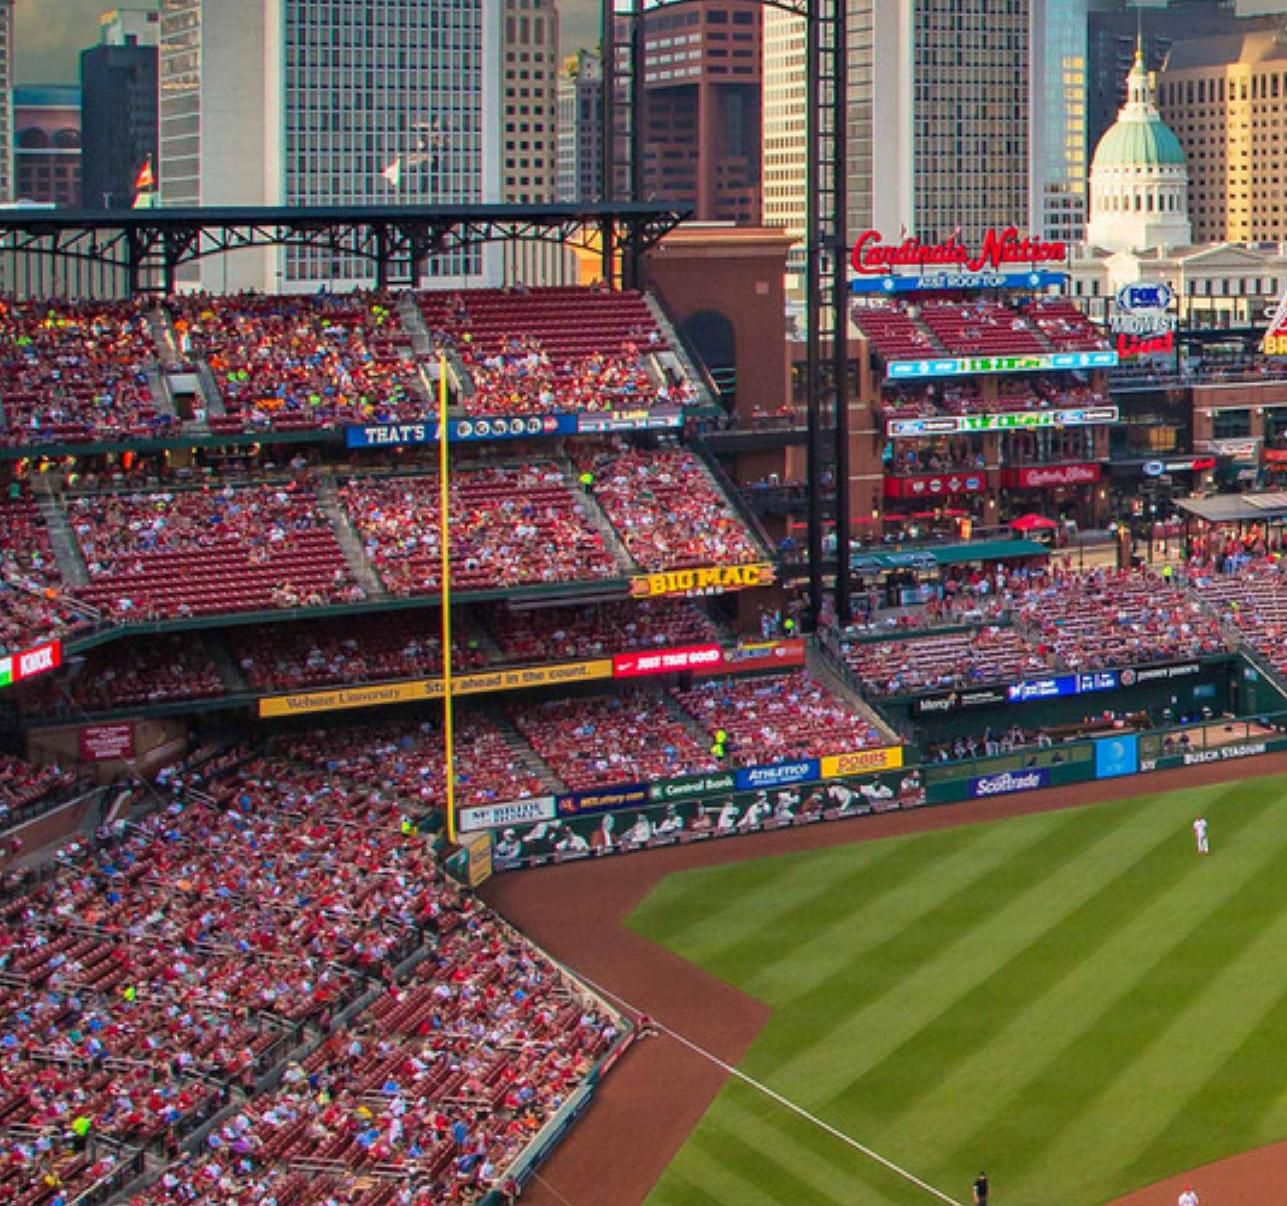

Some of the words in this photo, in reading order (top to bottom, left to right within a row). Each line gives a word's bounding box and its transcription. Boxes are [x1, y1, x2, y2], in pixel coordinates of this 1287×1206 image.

[851, 230, 968, 274] Cardinals
[967, 227, 1066, 272] Nation
[1130, 288, 1160, 302] FOX
[365, 424, 425, 443] THAT'S
[650, 569, 694, 597] BIG
[695, 564, 761, 587] MAC
[459, 674, 501, 690] ahead
[506, 672, 518, 686] in
[522, 669, 544, 683] the
[920, 699, 951, 713] Mercy
[1184, 751, 1219, 765] BUSCH
[1221, 742, 1266, 759] STADIUM
[748, 763, 809, 781] ATHLETICO
[665, 781, 704, 796] Central
[706, 775, 734, 790] Bank
[976, 772, 1041, 796] Scottrade
